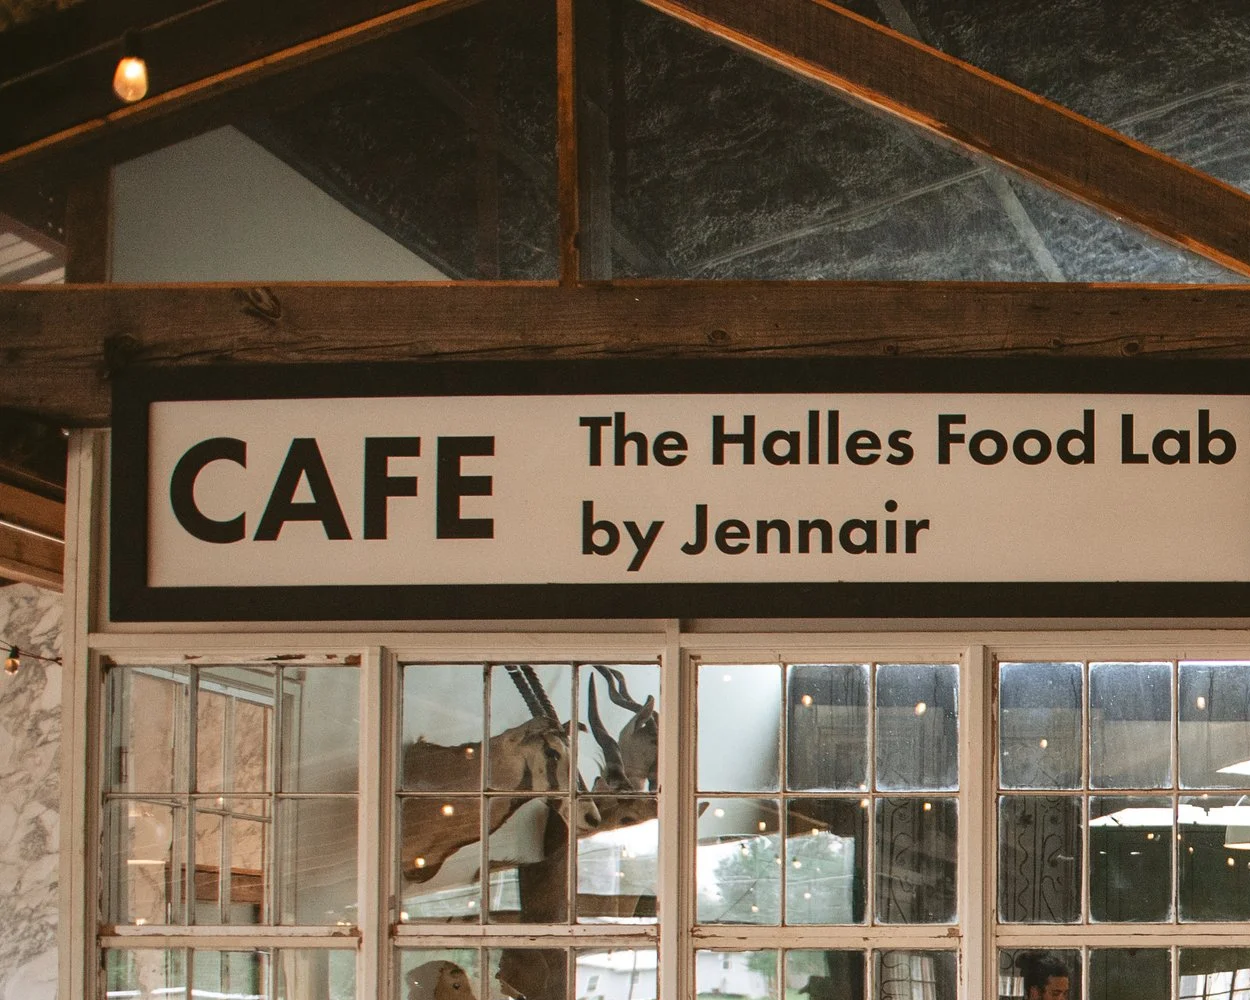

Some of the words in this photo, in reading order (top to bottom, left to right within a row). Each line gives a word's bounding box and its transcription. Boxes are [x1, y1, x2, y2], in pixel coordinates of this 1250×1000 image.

[578, 411, 690, 467] The
[712, 409, 915, 467] Halles
[937, 408, 1097, 466] Food
[1121, 408, 1238, 466] Lab
[170, 435, 496, 545] CAFE
[581, 500, 665, 573] by
[680, 499, 931, 556] Jennair
